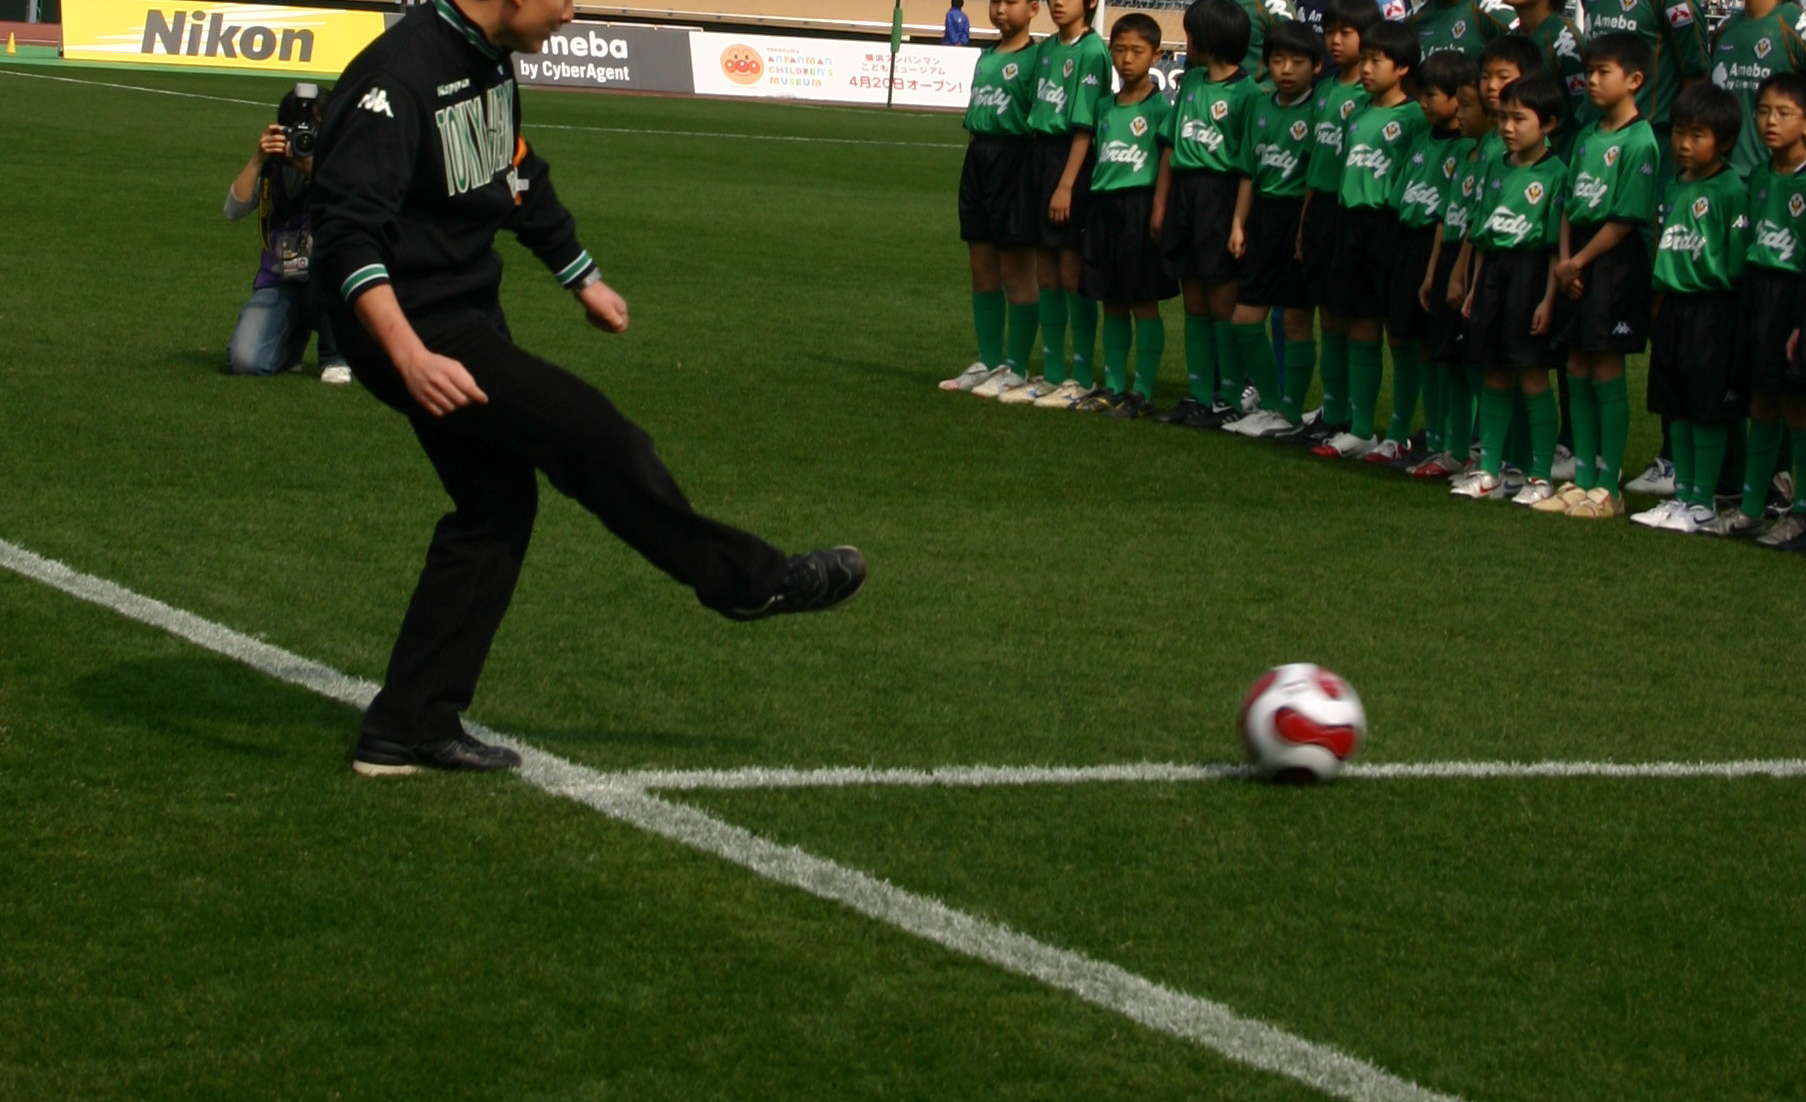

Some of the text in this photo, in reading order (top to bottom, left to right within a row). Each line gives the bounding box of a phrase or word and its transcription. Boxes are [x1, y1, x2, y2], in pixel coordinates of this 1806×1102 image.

[141, 8, 315, 63] Nikon
[541, 30, 629, 59] meba
[520, 59, 630, 83] by CyberAgent
[1729, 62, 1772, 79] Ameba
